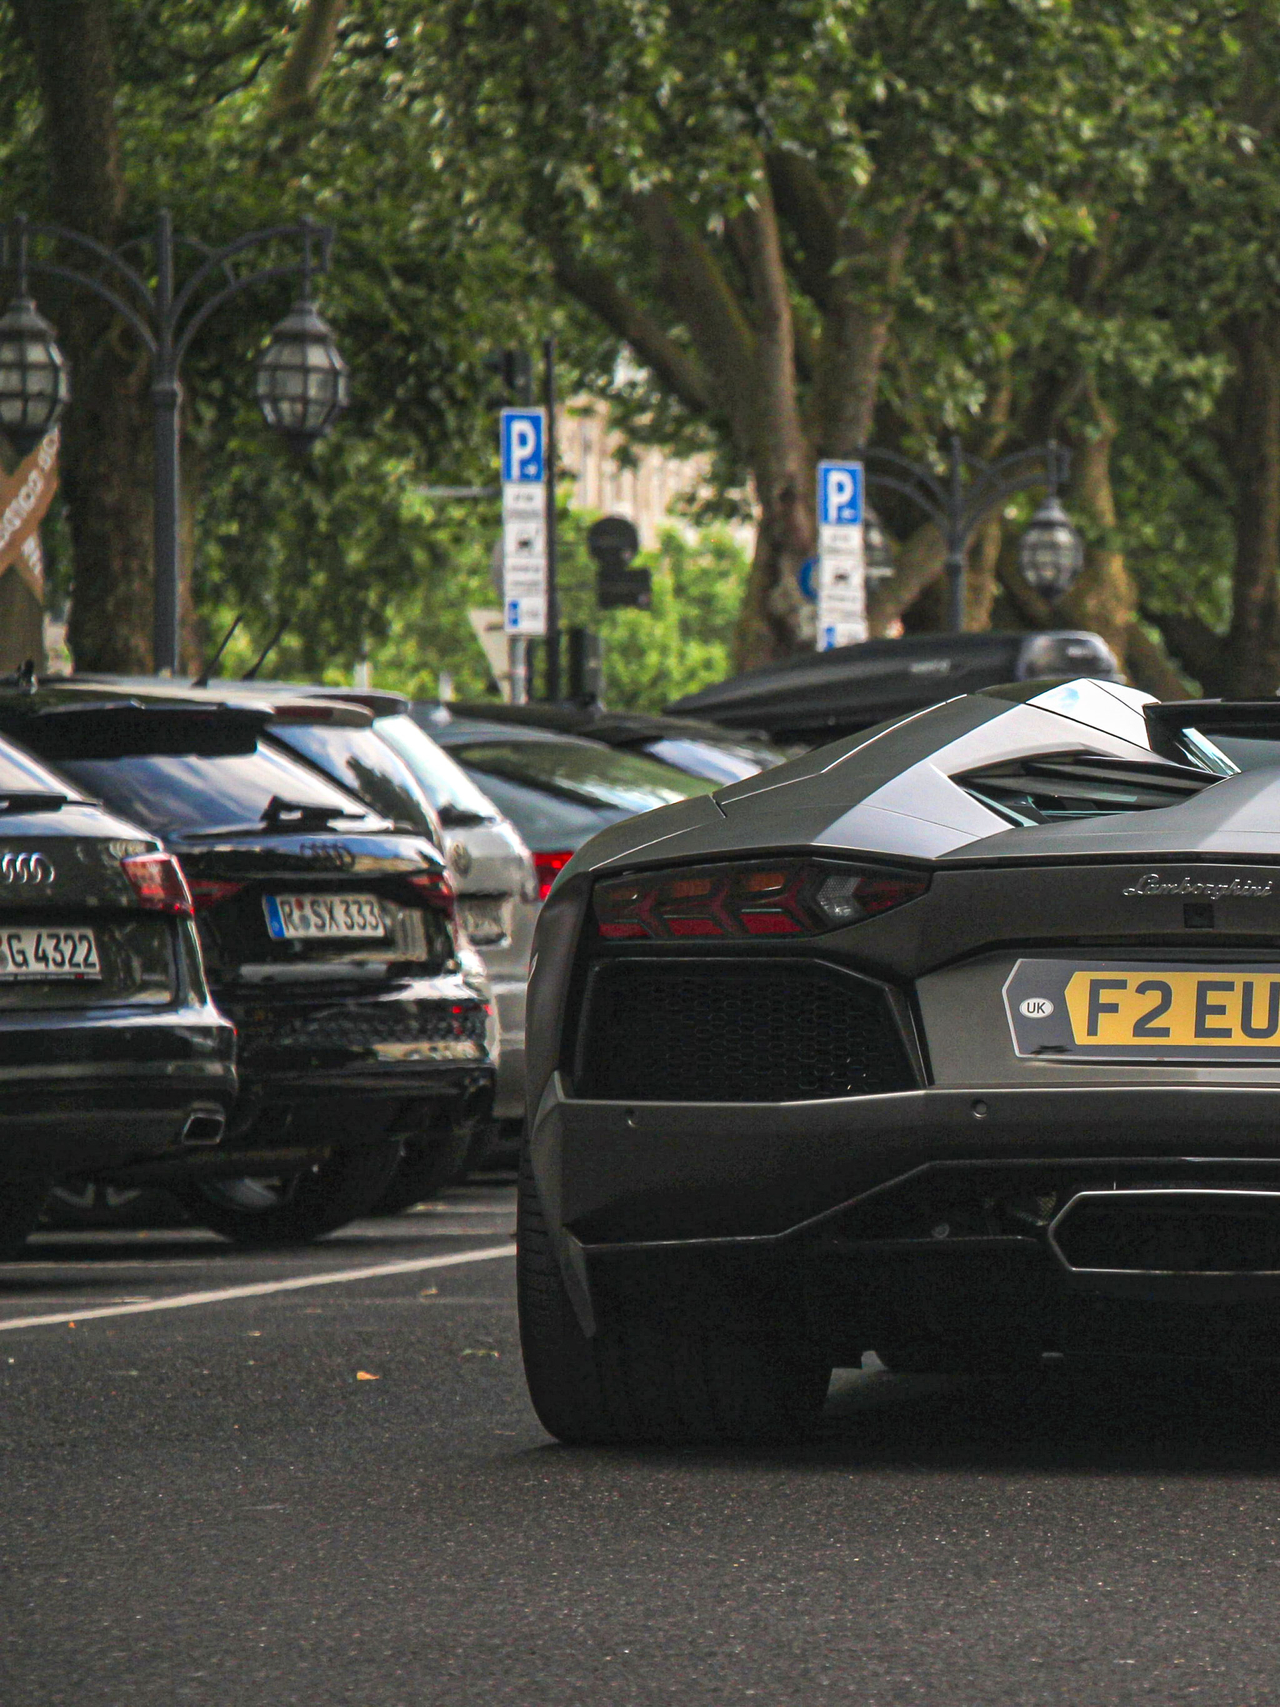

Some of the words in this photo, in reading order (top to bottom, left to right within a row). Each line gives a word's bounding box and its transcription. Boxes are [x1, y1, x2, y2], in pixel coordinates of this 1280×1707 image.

[511, 418, 537, 481] P
[828, 470, 855, 524] P
[1122, 873, 1274, 900] Lamborghini
[280, 901, 299, 933] R
[340, 900, 380, 931] 333
[34, 933, 97, 969] 4322
[1026, 1001, 1046, 1015] UK
[1087, 978, 1173, 1038] F2
